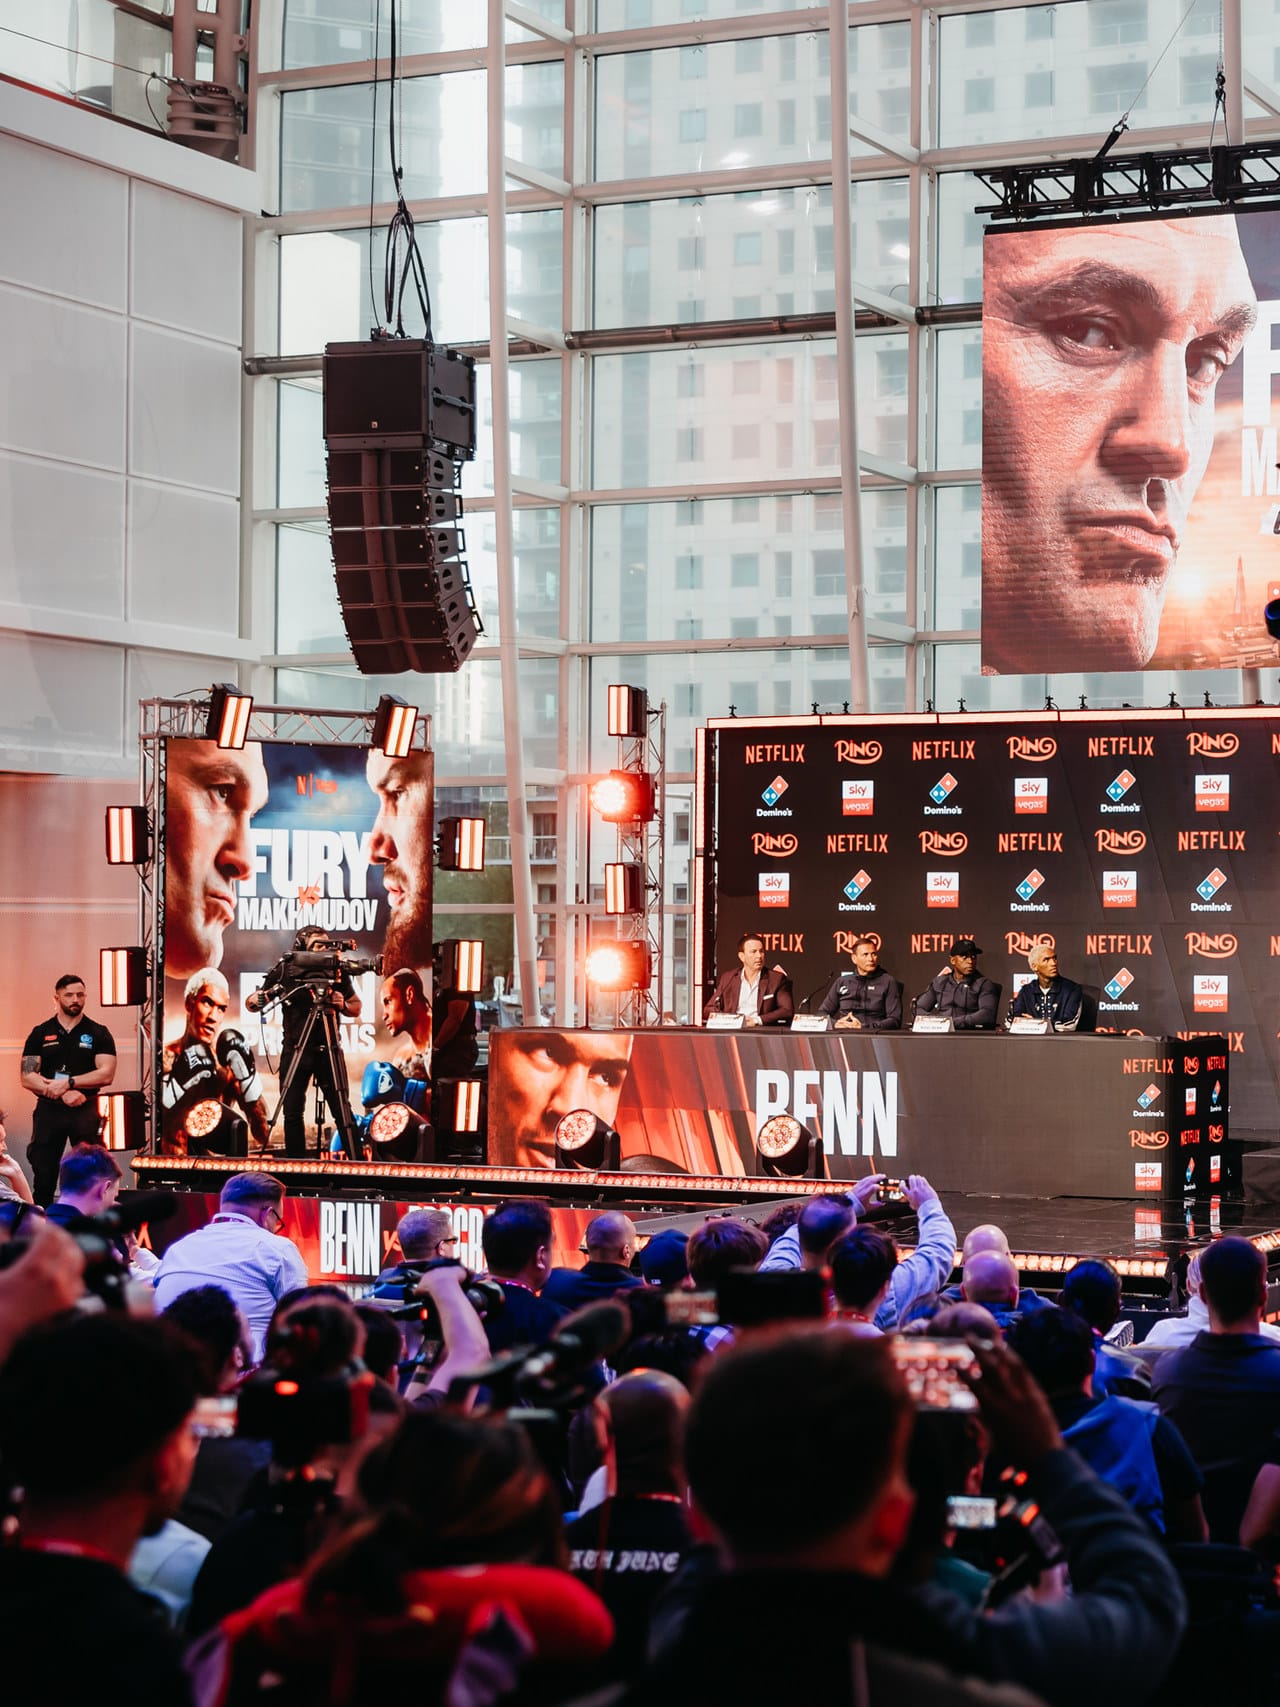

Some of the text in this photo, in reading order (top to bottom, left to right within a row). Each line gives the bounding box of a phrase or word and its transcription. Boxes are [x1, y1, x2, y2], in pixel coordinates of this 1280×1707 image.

[834, 736, 883, 765] RING
[912, 740, 976, 761] NETFLIX
[1006, 735, 1058, 762] RING
[1088, 735, 1155, 758] NETFLIX
[1185, 731, 1240, 759] RING
[745, 743, 805, 765] NETFLIX
[848, 784, 867, 797] sky
[1021, 782, 1041, 795] sky
[1202, 779, 1222, 792] sky
[844, 803, 870, 812] vegas
[1016, 801, 1044, 810] vegas
[1100, 803, 1141, 813] Domino's
[1197, 797, 1225, 807] vegas
[756, 807, 793, 817] Domino's
[923, 805, 963, 815] Domino's
[751, 832, 799, 858] RING
[827, 833, 889, 854] NETFLIX
[918, 830, 968, 857] RING
[998, 832, 1063, 853] NETFLIX
[1094, 828, 1147, 855] RING
[1177, 830, 1246, 852] NETFLIX
[239, 828, 373, 899] FURY
[765, 877, 783, 889] sky
[933, 876, 953, 889] sky
[1110, 875, 1129, 889] sky
[760, 894, 786, 903] vegas
[928, 894, 955, 903] vegas
[1105, 894, 1133, 904] vegas
[838, 902, 876, 912] Domino's
[1010, 902, 1050, 912] Domino's
[1190, 901, 1233, 912] Domino's
[238, 897, 378, 932] MAKHMUDOV
[1086, 934, 1153, 956] NETFLIX
[1184, 931, 1238, 959] RING
[1200, 979, 1221, 993] sky
[1098, 1001, 1140, 1011] Domino's
[1196, 998, 1224, 1008] vegas
[1122, 1059, 1174, 1075] NETFLIX
[1127, 1129, 1170, 1151] RING
[320, 1202, 380, 1276] BENN
